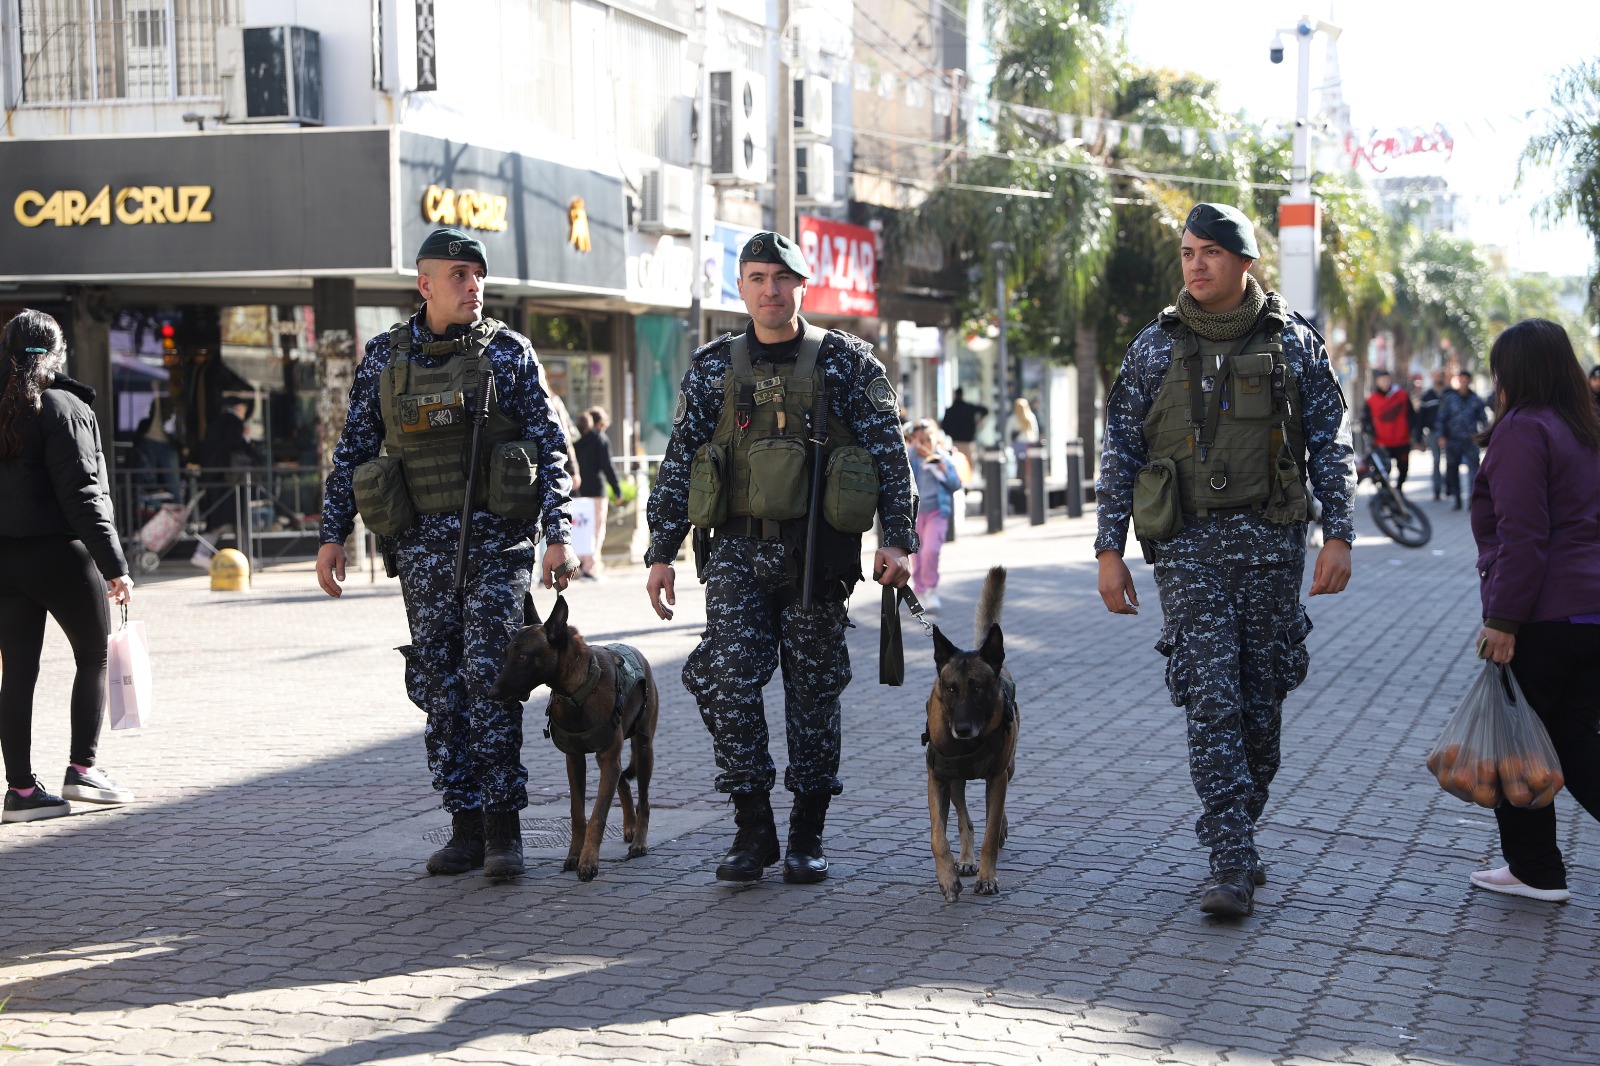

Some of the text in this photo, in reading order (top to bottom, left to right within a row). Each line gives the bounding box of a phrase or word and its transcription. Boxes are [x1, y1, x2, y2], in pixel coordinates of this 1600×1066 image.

[14, 184, 212, 227] CARA CRUZ
[801, 230, 876, 293] BAZAR
